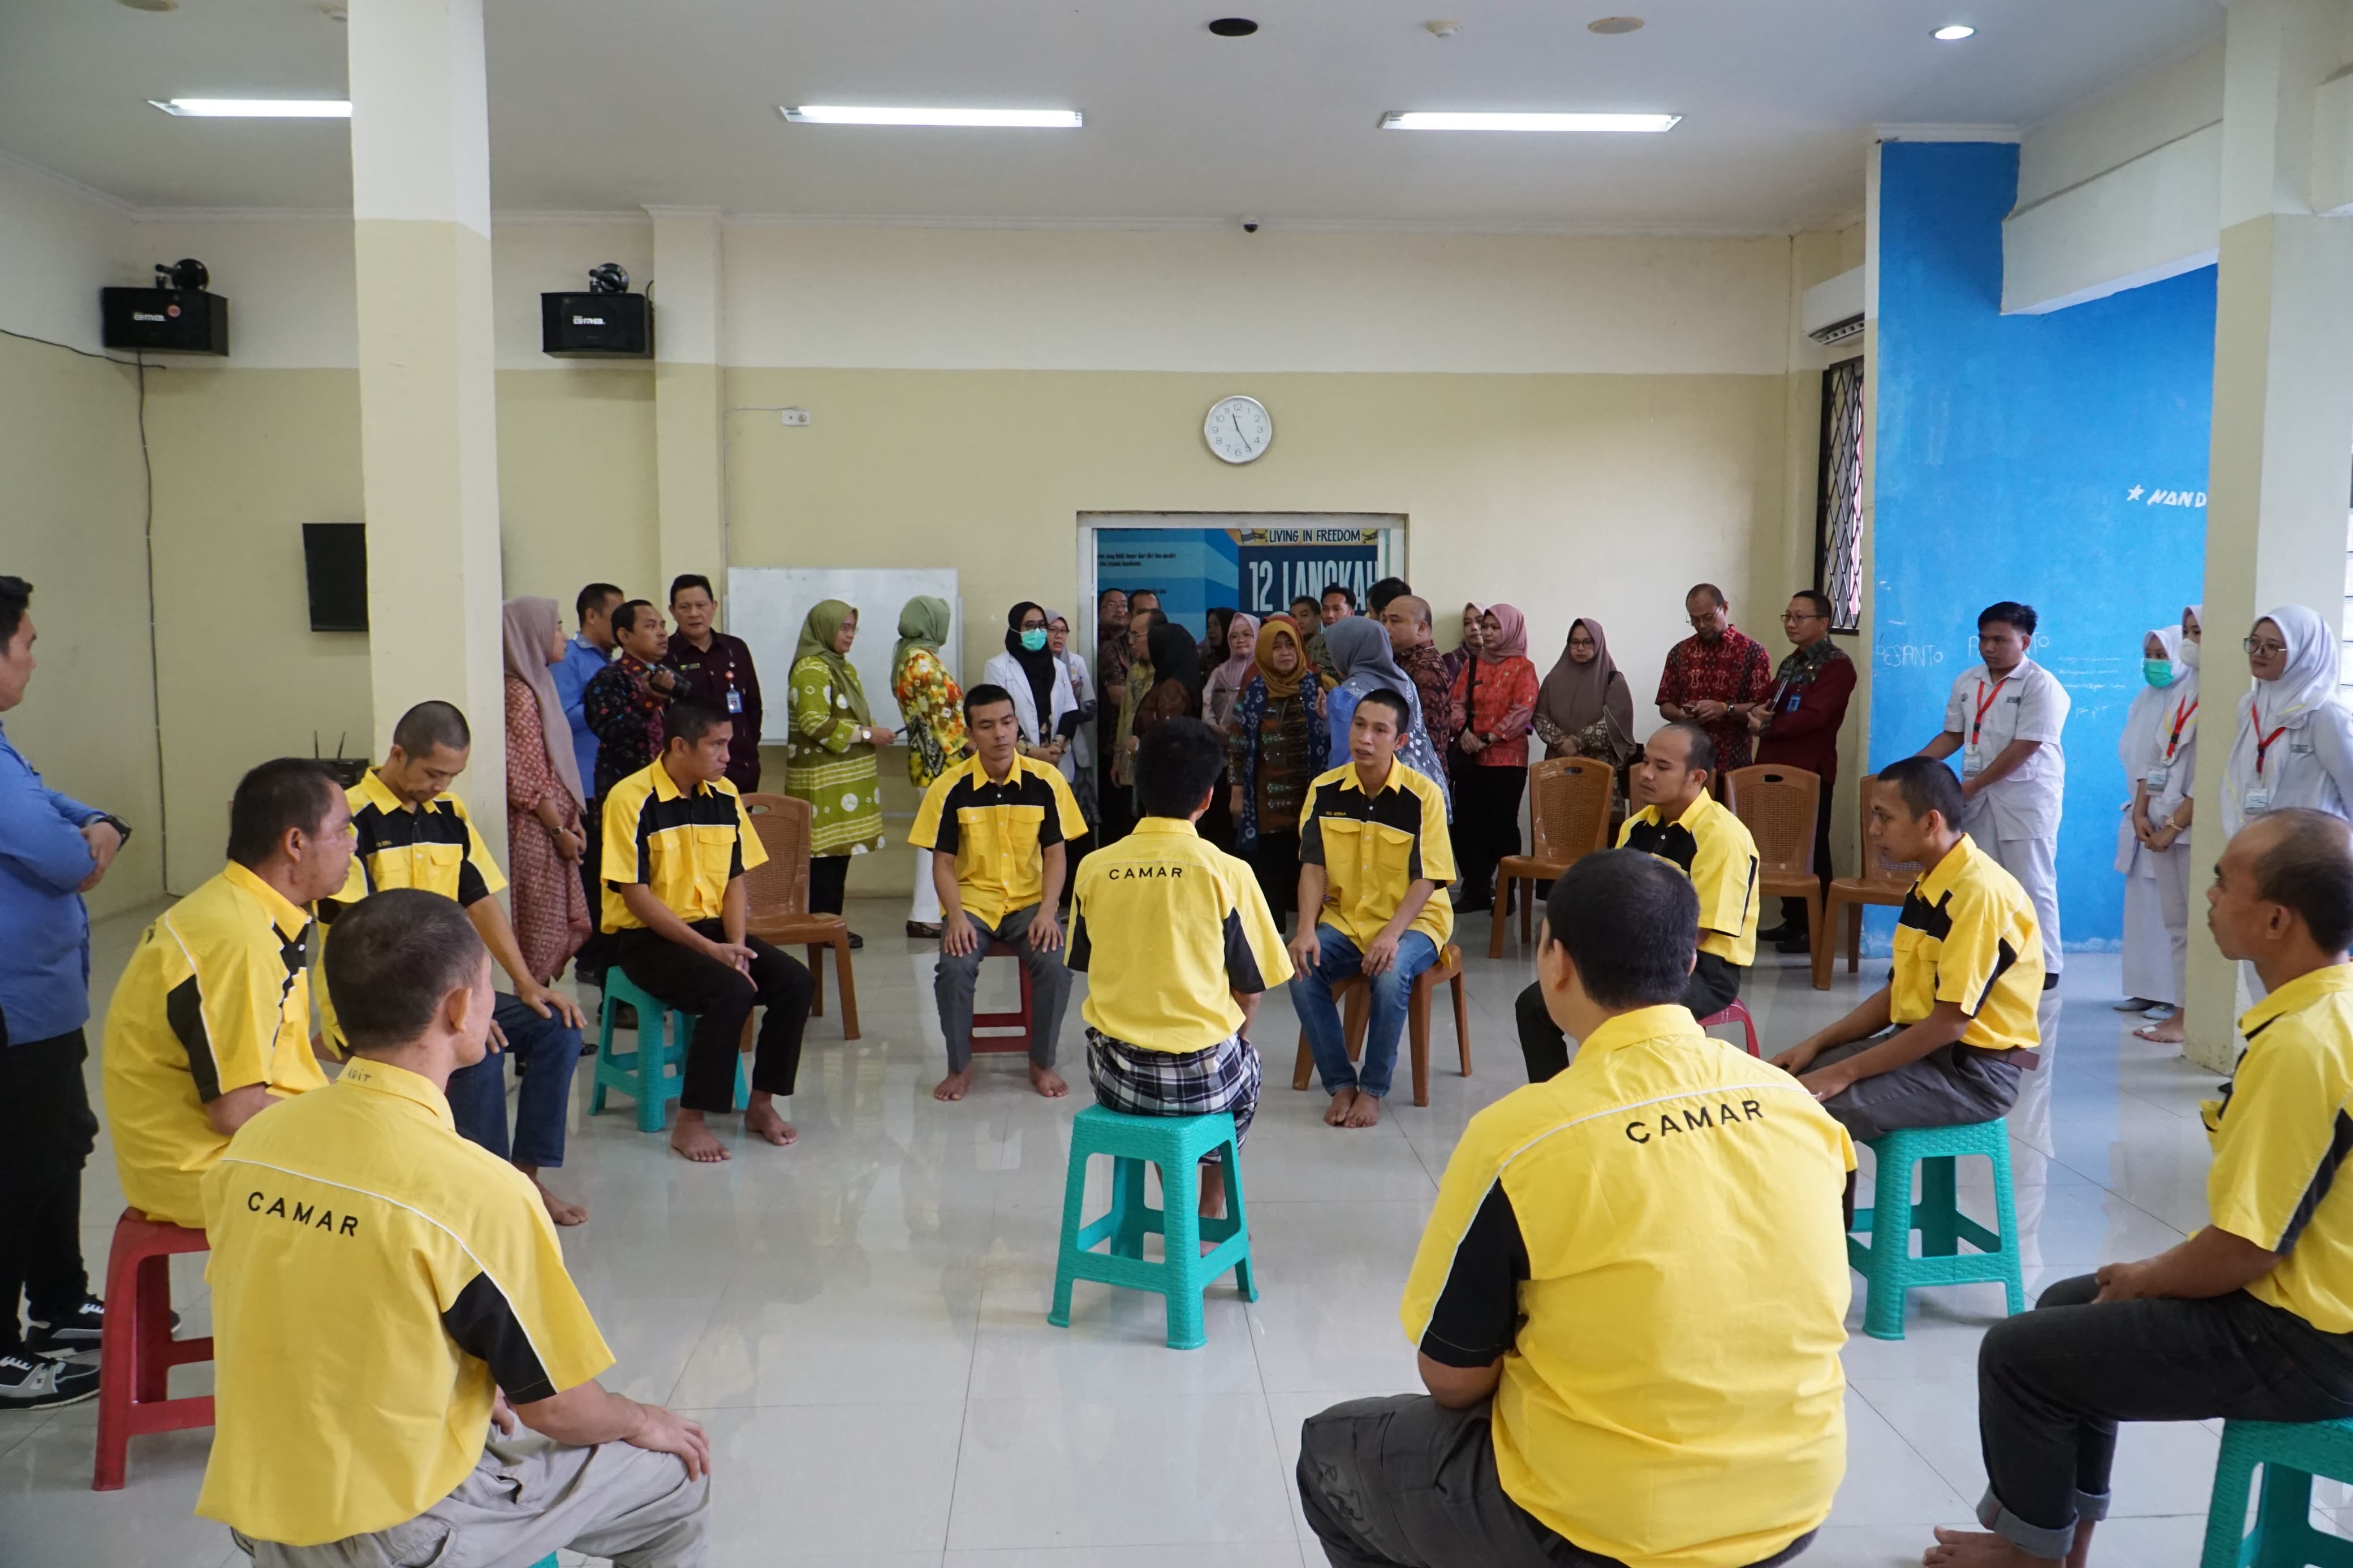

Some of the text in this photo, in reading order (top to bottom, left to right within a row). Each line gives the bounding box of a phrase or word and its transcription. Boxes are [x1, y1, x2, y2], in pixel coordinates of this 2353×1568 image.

[1269, 529, 1360, 543] LIVING IN FREEDOM
[1249, 560, 1273, 612] 12
[1109, 867, 1182, 880] CAMAR
[1626, 1100, 1764, 1144] CAMAR
[247, 1191, 358, 1237] CAMAR
